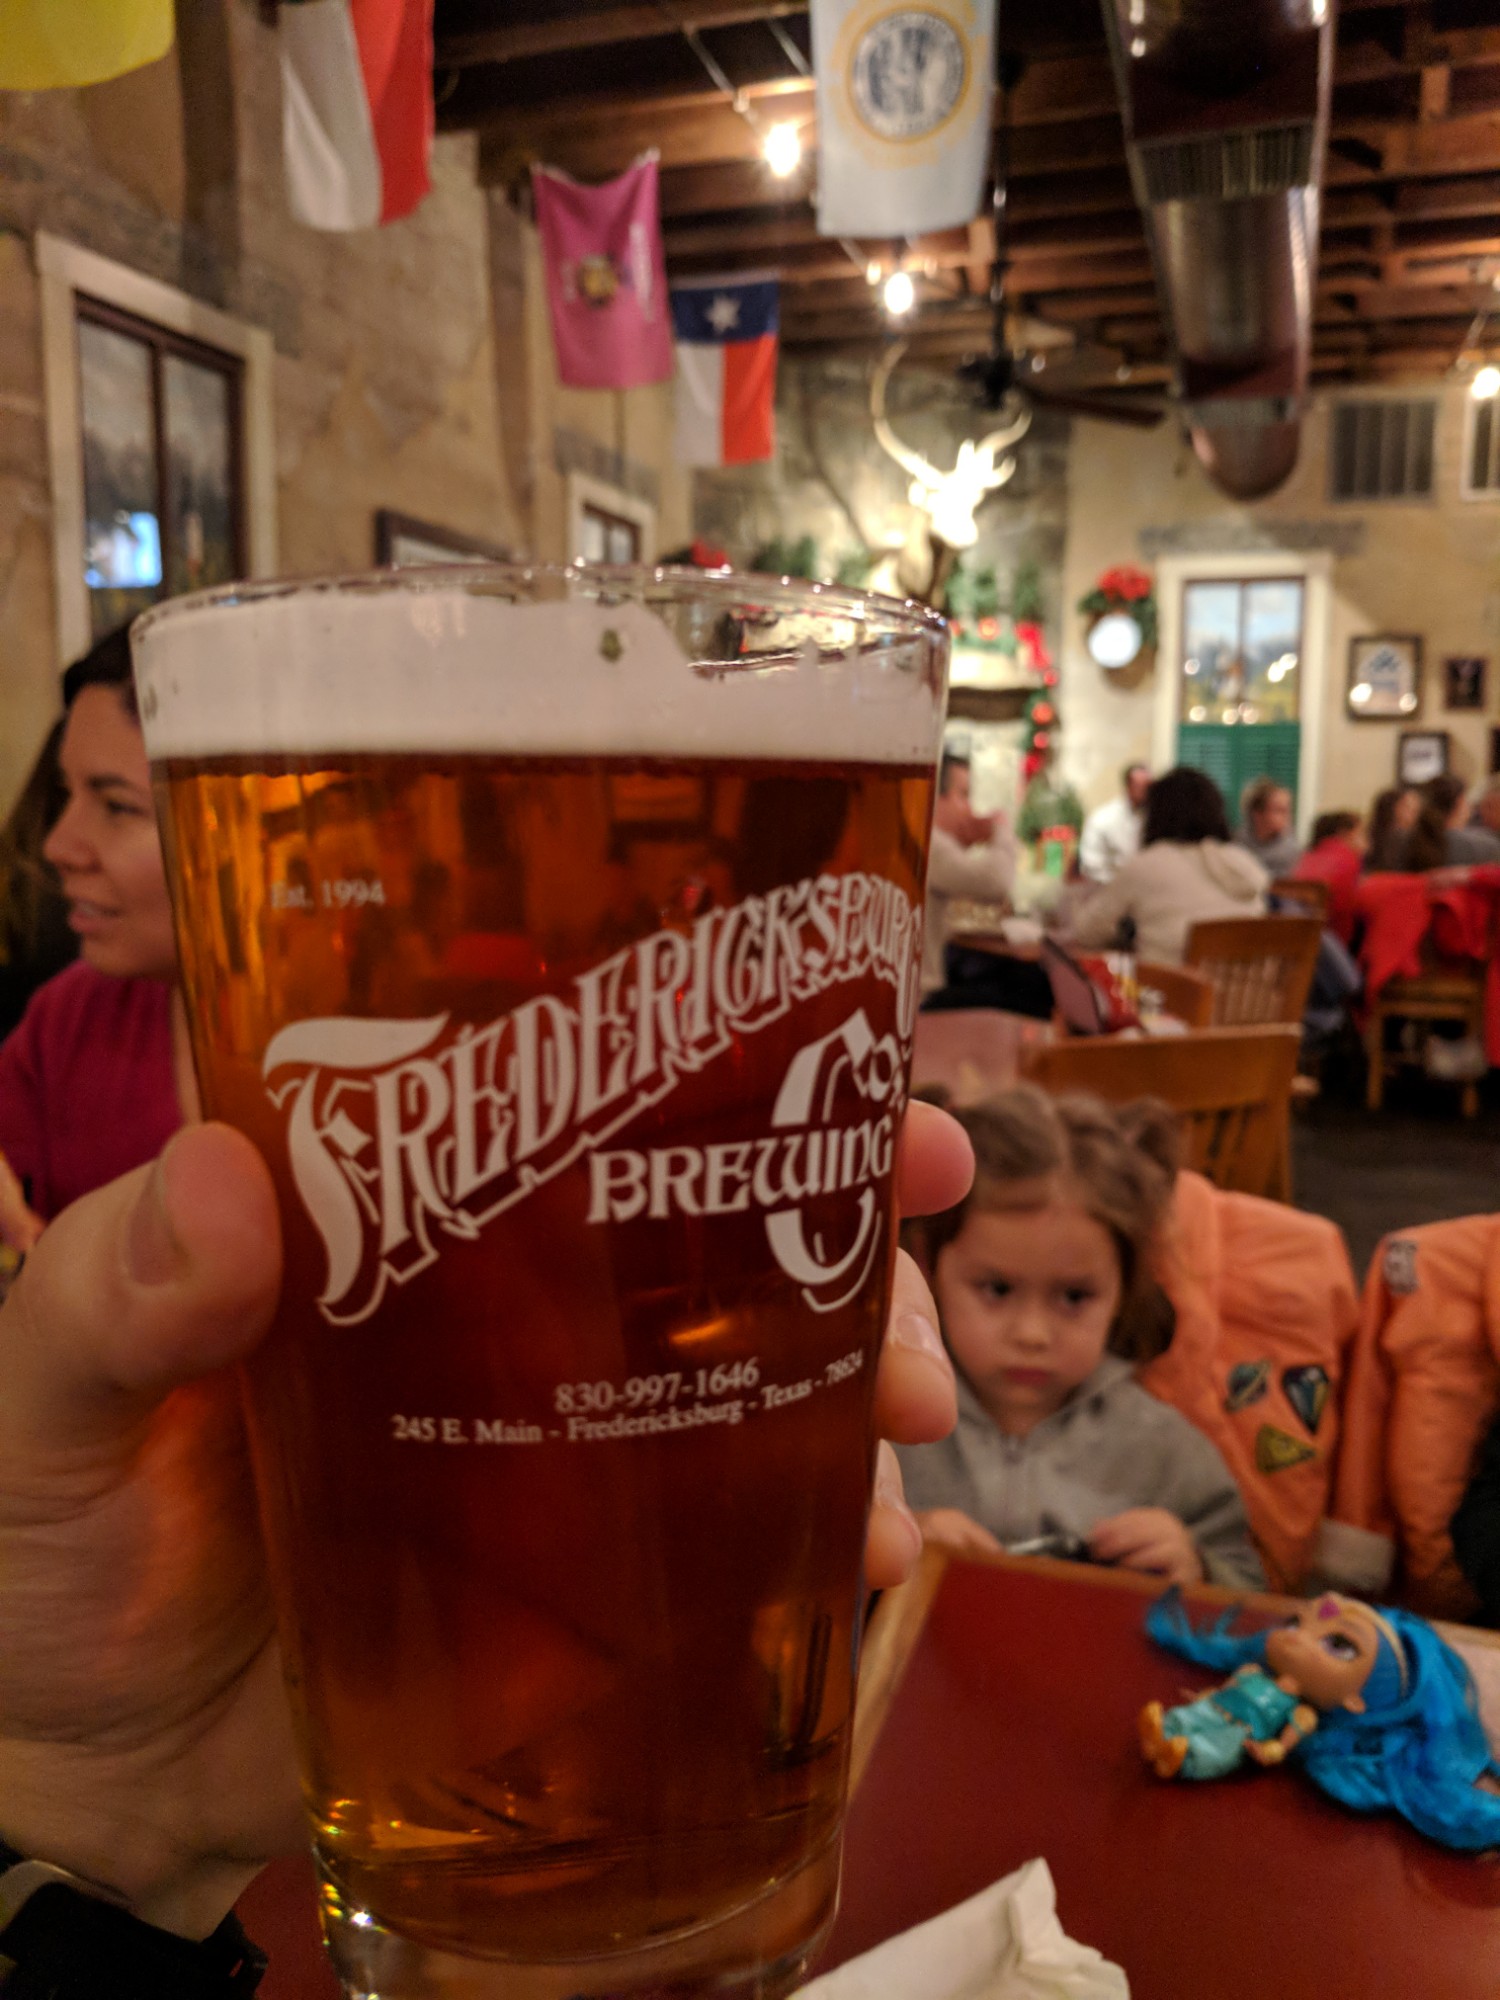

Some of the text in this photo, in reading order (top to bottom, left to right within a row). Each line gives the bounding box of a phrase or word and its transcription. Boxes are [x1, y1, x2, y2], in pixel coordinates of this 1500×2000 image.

[320, 877, 386, 908] 1994
[391, 1413, 436, 1443] 245
[441, 1417, 469, 1445] E.
[474, 1417, 544, 1445] Main
[566, 1400, 744, 1442] Fredericksburg
[760, 1378, 813, 1409] Texas
[554, 1356, 760, 1414] 830-997-1646
